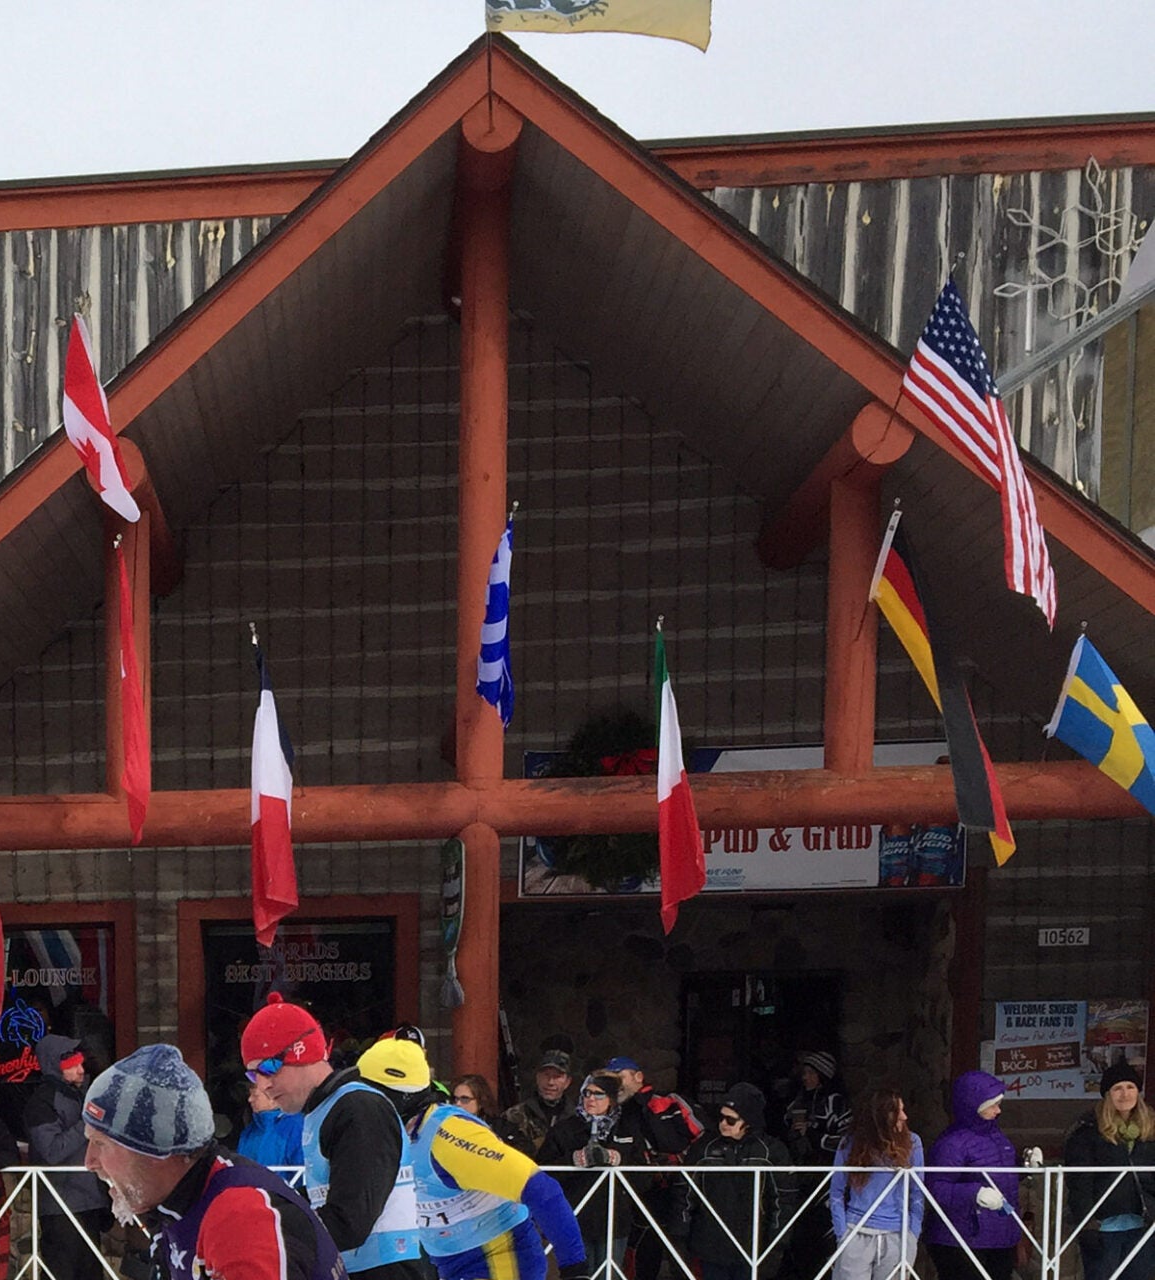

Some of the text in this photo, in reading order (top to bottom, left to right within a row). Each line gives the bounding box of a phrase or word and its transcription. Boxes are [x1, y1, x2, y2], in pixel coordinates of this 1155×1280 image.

[704, 825, 872, 854] Pub & Grub
[1044, 929, 1084, 944] 10562
[224, 962, 372, 983] BEST BURGERS
[1003, 1003, 1078, 1015] WELCOME SKIERS
[1015, 1016, 1037, 1028] RACE
[1039, 1016, 1061, 1028] FANS
[1063, 1016, 1074, 1028] TO
[1001, 1059, 1038, 1073] BOCK!
